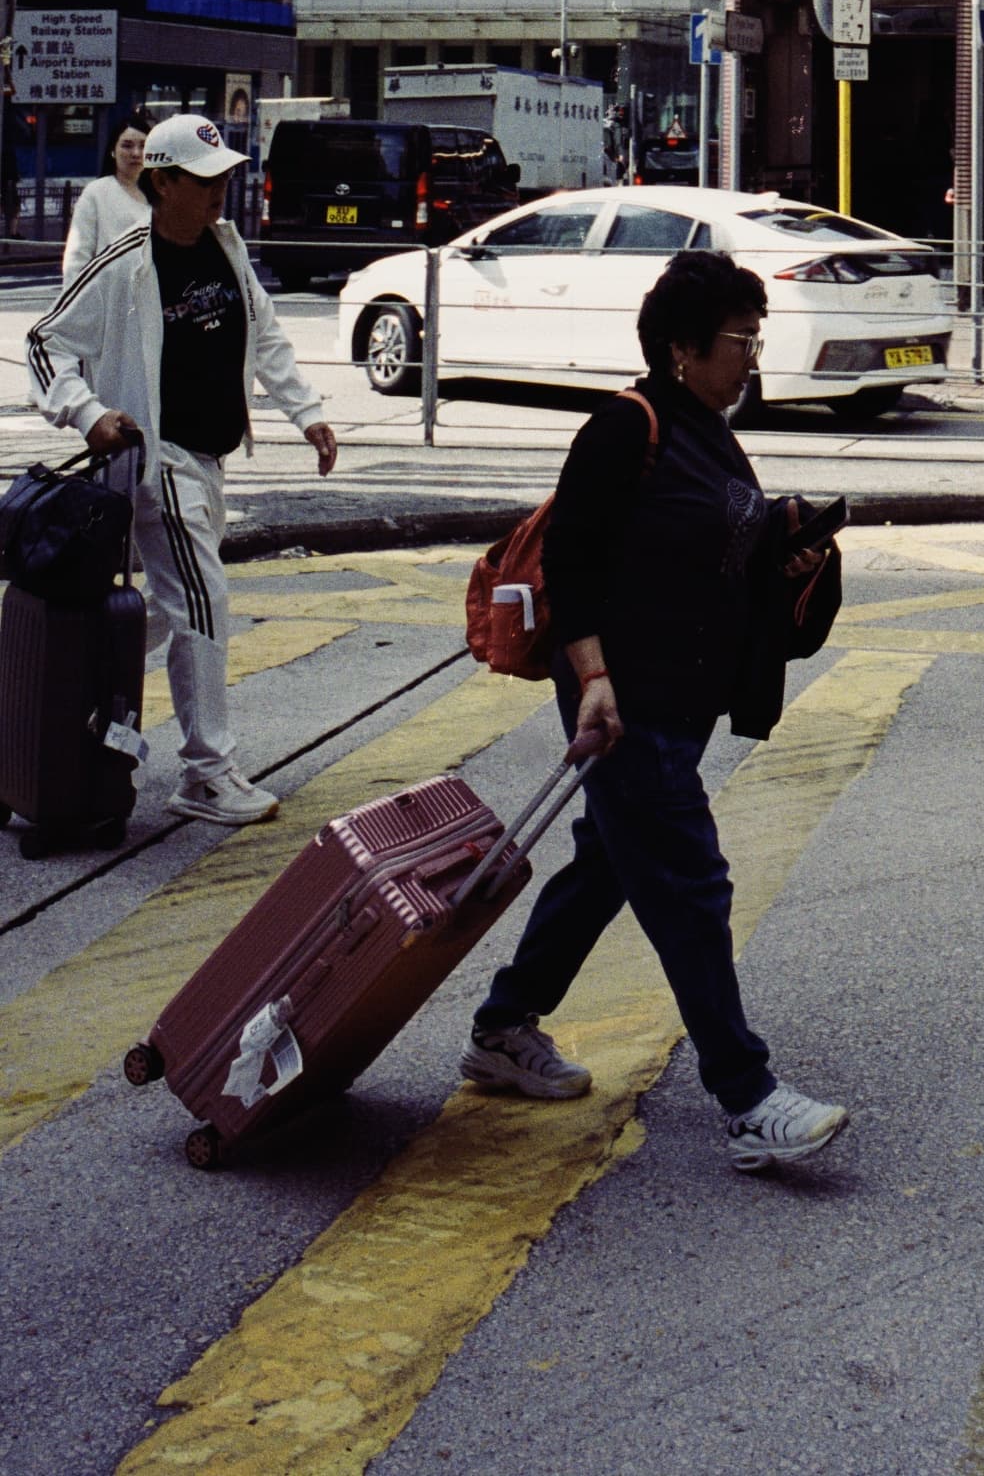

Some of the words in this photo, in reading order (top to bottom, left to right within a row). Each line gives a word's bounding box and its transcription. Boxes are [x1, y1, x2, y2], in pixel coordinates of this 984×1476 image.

[41, 15, 66, 25] High
[70, 14, 103, 25] Speed
[31, 26, 72, 37] Railway
[75, 26, 112, 36] Station
[30, 57, 67, 68] Airport
[71, 57, 112, 68] Express
[52, 69, 91, 79] Station
